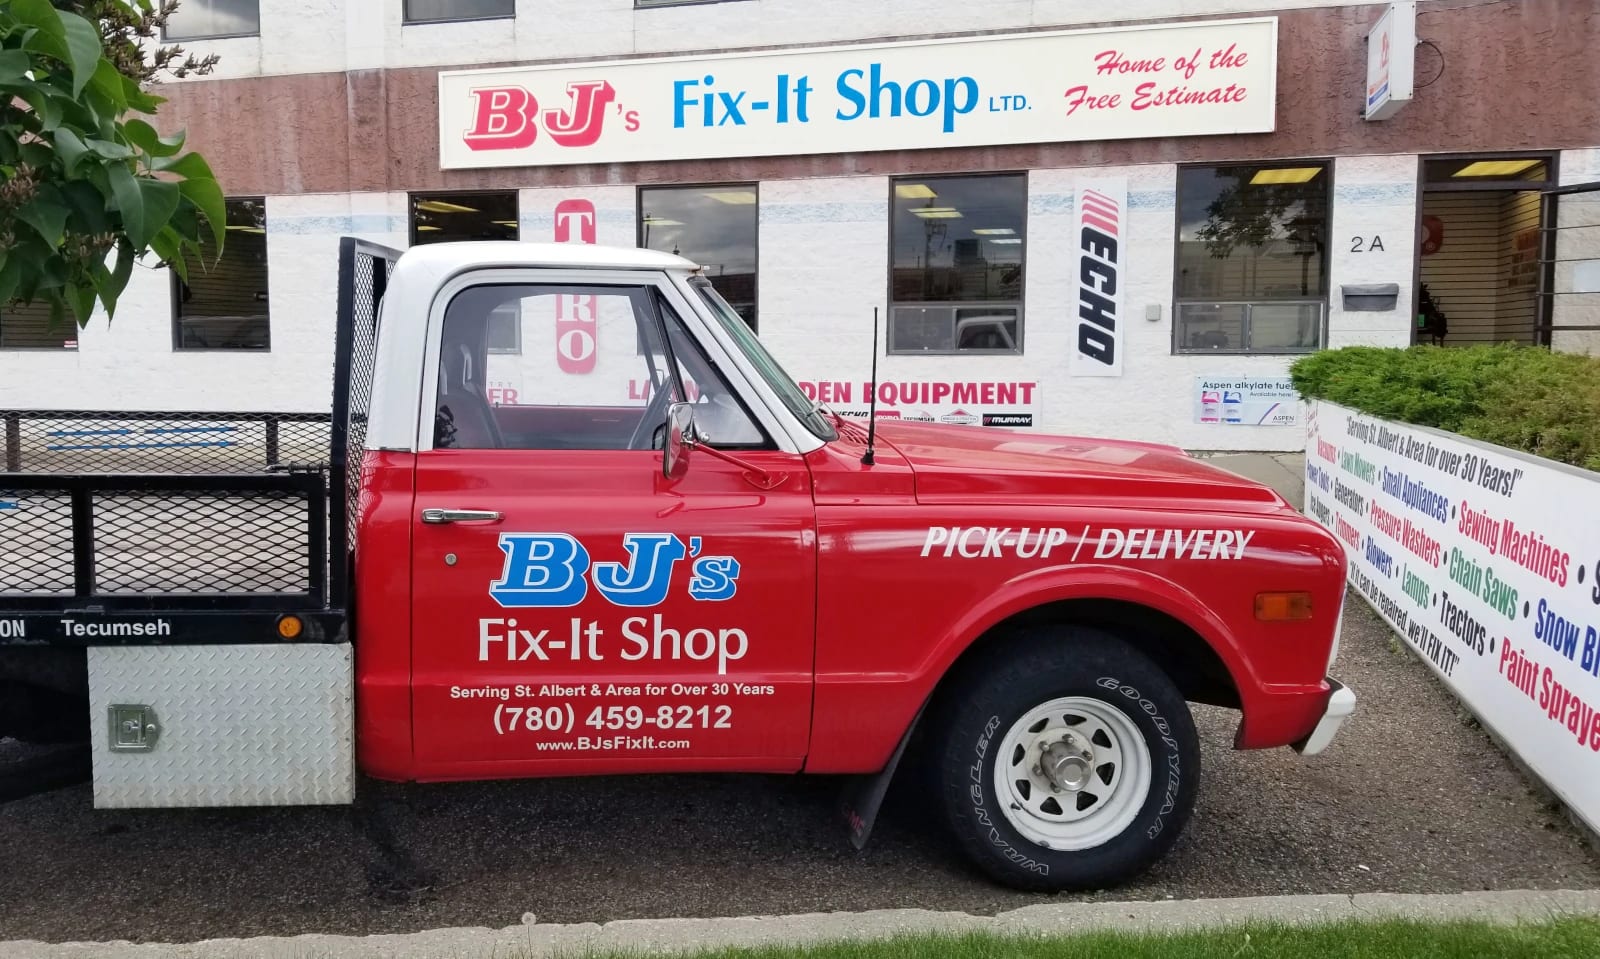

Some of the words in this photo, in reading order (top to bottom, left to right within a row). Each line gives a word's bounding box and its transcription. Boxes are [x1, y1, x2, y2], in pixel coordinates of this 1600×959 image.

[1094, 50, 1166, 76] Home
[1173, 48, 1202, 80] of
[1209, 42, 1249, 69] the
[463, 80, 640, 151] BJ's
[673, 74, 813, 129] Fix-It
[836, 63, 979, 133] Shop
[989, 95, 1032, 112] LTD.
[1064, 85, 1122, 117] Free
[1130, 81, 1248, 111] Estimate
[1078, 226, 1118, 367] ECHO
[1202, 381, 1232, 391] Aspen
[1234, 381, 1273, 391] alkylate
[991, 416, 1031, 424] MURRAY
[1377, 426, 1400, 453] Albert
[1398, 436, 1405, 456] &
[1405, 435, 1423, 463] Area
[1423, 441, 1440, 470] for
[1438, 449, 1462, 477] over
[1461, 453, 1478, 483] 30
[920, 526, 1067, 558] PICK-UP
[1094, 528, 1255, 560] DELIVERY
[1382, 465, 1403, 499] Small
[1402, 474, 1449, 524] Appliances
[1458, 499, 1501, 556] Sewing
[1500, 518, 1570, 588] Machines
[489, 532, 741, 608] BJ's
[1370, 498, 1402, 543] Pressure
[1401, 517, 1441, 569] Washers
[1449, 546, 1482, 598] Chain
[1482, 566, 1518, 621] Saws
[1534, 598, 1580, 662] Snow
[61, 618, 171, 637] Tecumseh
[479, 617, 605, 662] Fix-It
[620, 613, 750, 676] Shop
[1366, 533, 1393, 579] Blowers
[1401, 562, 1430, 610] Lamps
[1440, 590, 1487, 657] Tractors
[1499, 636, 1539, 701] Paint
[1370, 580, 1379, 603] be
[1426, 632, 1442, 666] FIX
[450, 685, 510, 701] Serving
[514, 684, 535, 698] St.
[539, 684, 587, 698] Albert
[590, 683, 602, 697] &
[605, 683, 641, 697] Area
[645, 683, 668, 696] for
[671, 683, 708, 696] Over
[711, 683, 729, 695] 30
[733, 683, 775, 695] Years
[493, 702, 575, 735] (780)
[585, 704, 732, 731] 459-8212
[535, 735, 691, 751] www.BJsFixIt.com
[1096, 677, 1181, 840] GOODYEAR
[970, 715, 1050, 876] WRANGLER
